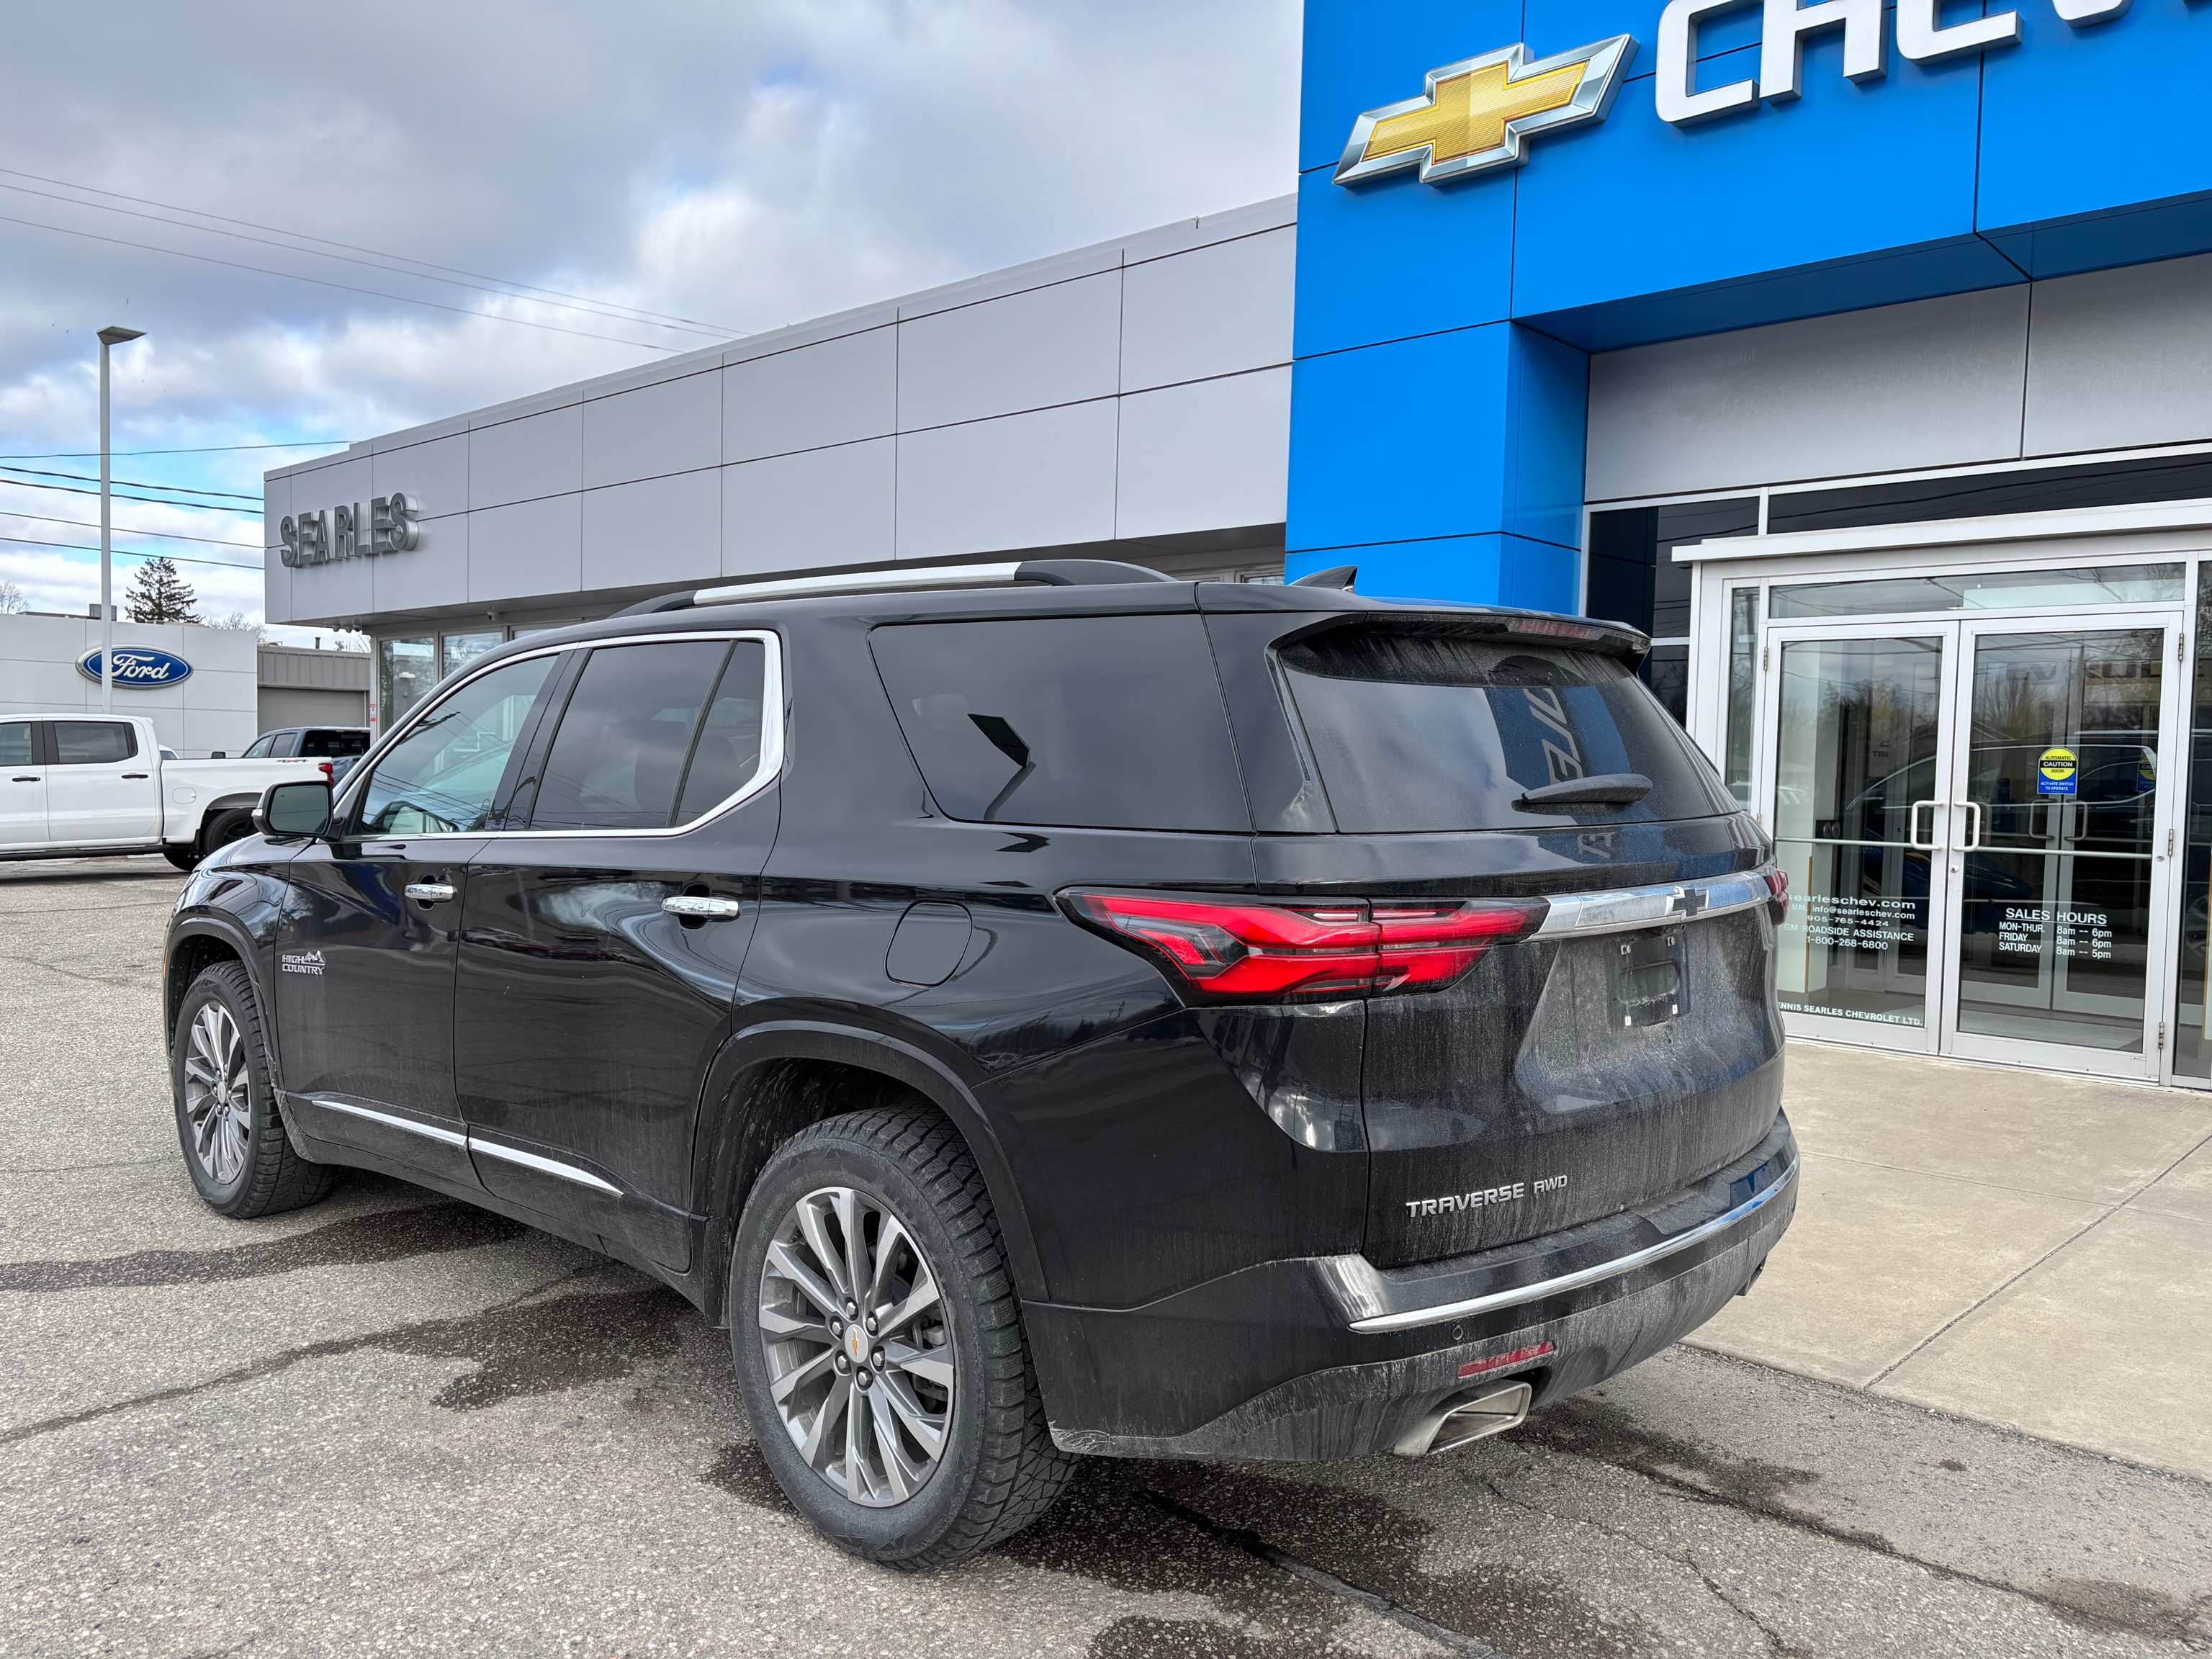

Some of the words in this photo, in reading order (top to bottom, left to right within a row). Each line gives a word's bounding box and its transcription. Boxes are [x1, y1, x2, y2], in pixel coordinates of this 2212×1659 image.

[280, 493, 414, 567] SEARLES
[111, 653, 171, 679] Ford
[1812, 904, 1915, 920] info@searleschev.com
[2005, 907, 2051, 921] SALES
[2056, 911, 2108, 925] HOURS
[1807, 915, 1889, 927] 905-765-4424
[1999, 921, 2046, 933] MON-THUR.
[2056, 926, 2076, 935] 8am
[2092, 928, 2113, 938] 6pm
[1784, 923, 1799, 932] GM
[1802, 925, 1850, 936] ROADSIDE
[1853, 930, 1915, 941] ASSISTANCE
[1999, 932, 2028, 942] FRIDAY
[2056, 936, 2076, 945] 8am
[2092, 938, 2112, 949] 6pm
[1807, 936, 1889, 950] 1-800-268-6800
[1998, 941, 2042, 953] SATURDAY
[2056, 947, 2075, 956] 8am
[2091, 948, 2111, 960] 5pm
[282, 954, 305, 963] HIGH
[282, 963, 325, 976] COUNTRY
[1803, 1004, 1843, 1017] SEARLES
[1845, 1009, 1900, 1023] CHEVROLET
[1902, 1016, 1923, 1025] LTD.
[1406, 1182, 1525, 1218] TRAVERSE
[1533, 1174, 1568, 1195] AWD
